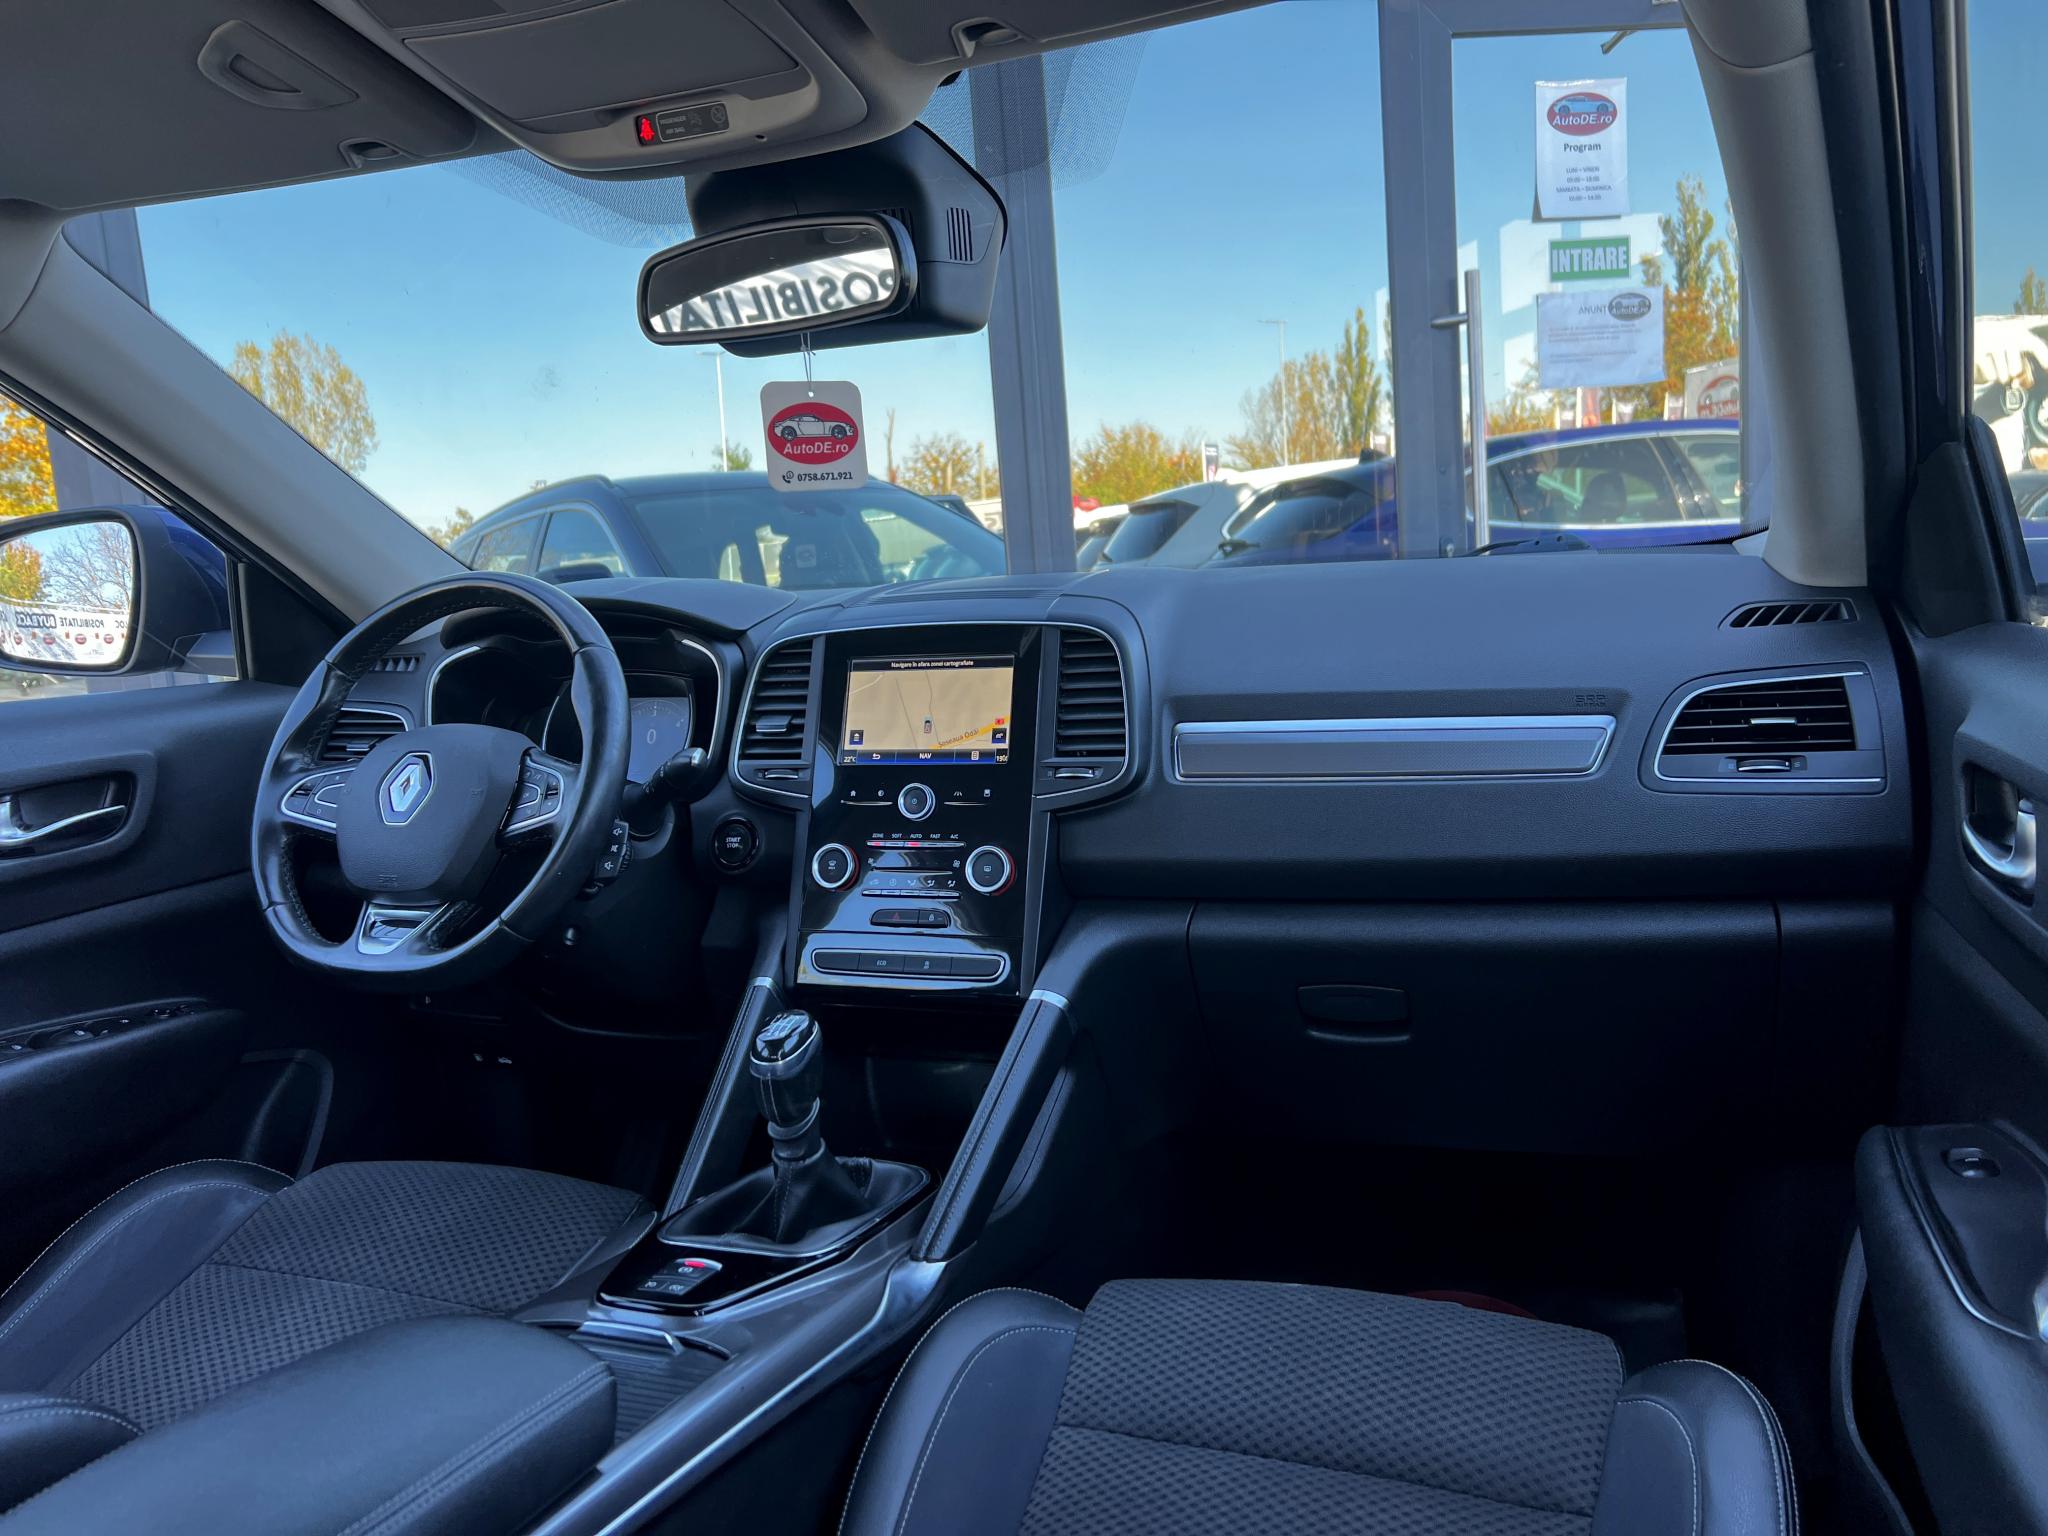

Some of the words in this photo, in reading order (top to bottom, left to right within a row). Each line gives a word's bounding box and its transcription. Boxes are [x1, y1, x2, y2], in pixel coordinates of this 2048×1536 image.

[1552, 112, 1614, 126] AutoDE.ro
[1563, 142, 1602, 154] Program
[1552, 246, 1627, 273] INTRARE
[783, 442, 849, 455] AutoDE.ro
[797, 472, 853, 482] 0758.671.921
[919, 752, 932, 760] NAV
